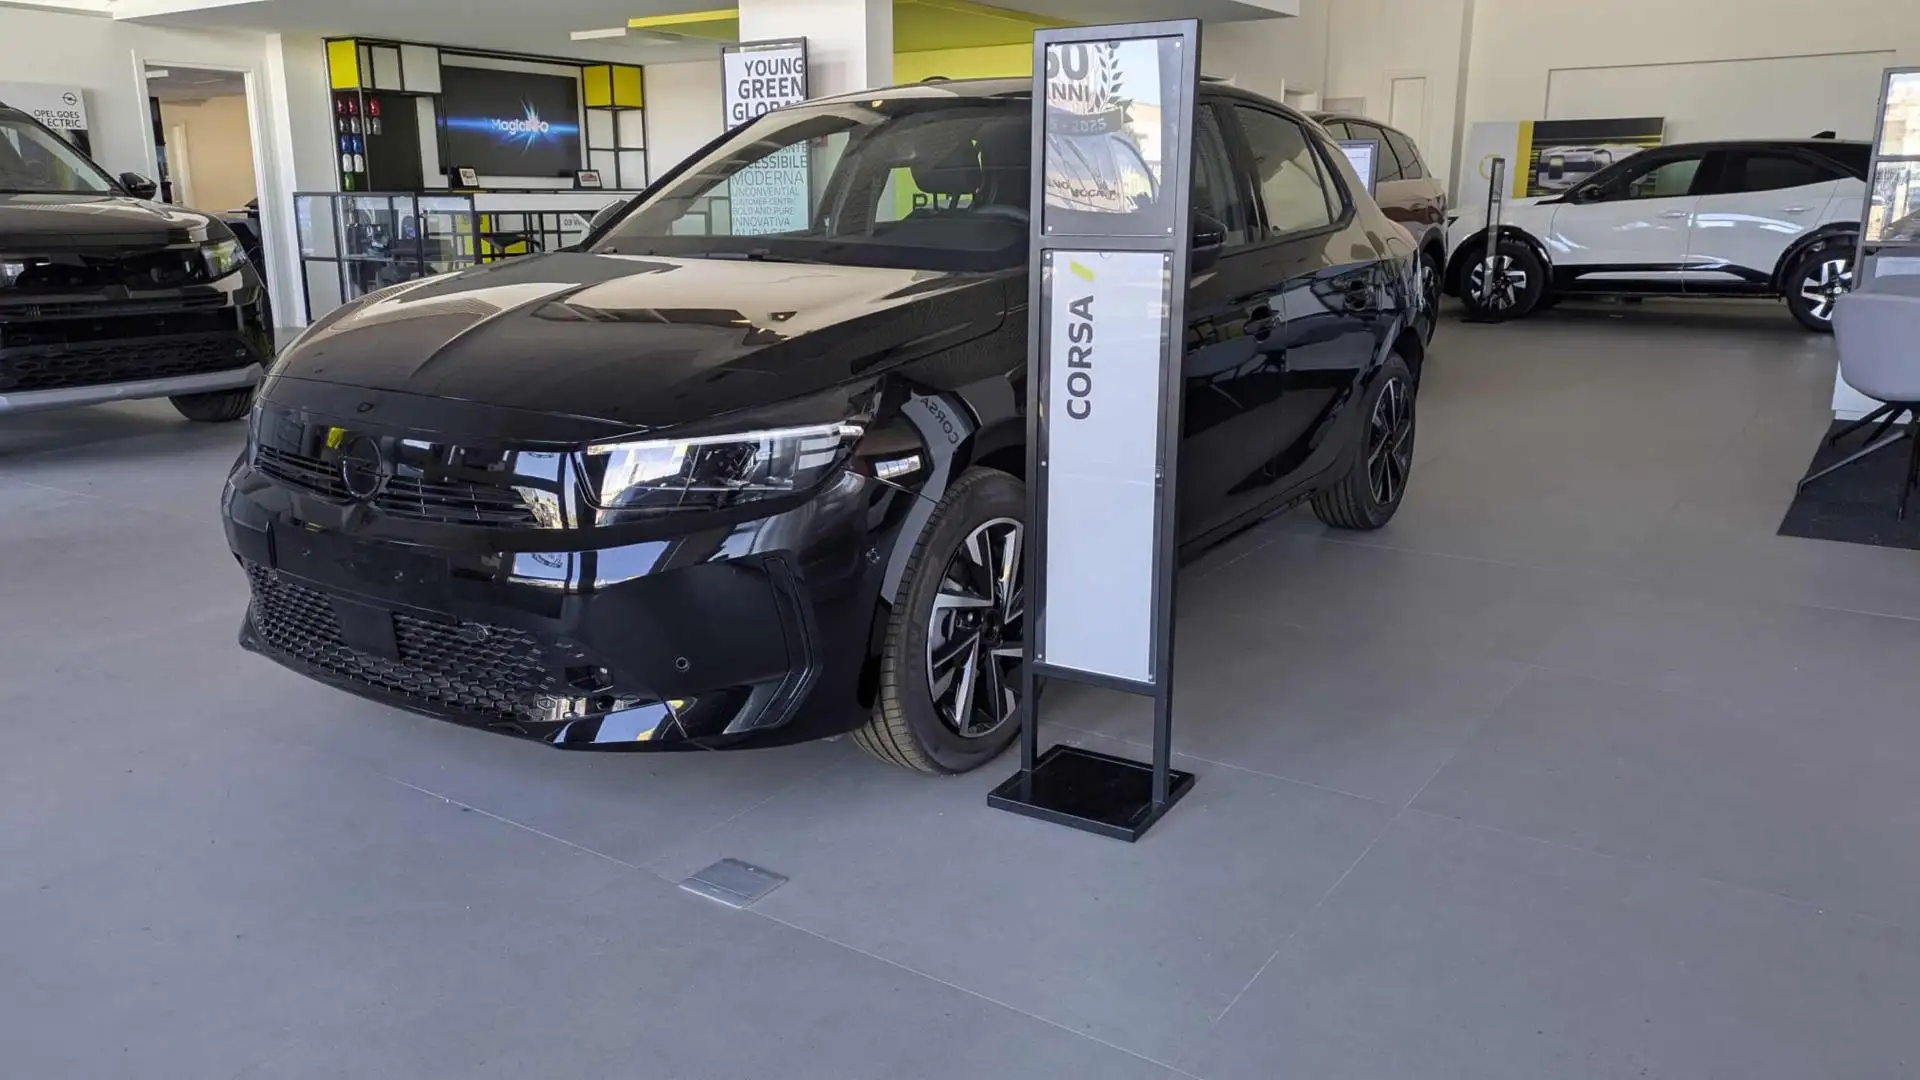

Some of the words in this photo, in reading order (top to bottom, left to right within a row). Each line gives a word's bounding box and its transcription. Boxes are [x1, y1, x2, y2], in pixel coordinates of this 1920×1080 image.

[745, 57, 803, 76] YOUNG
[738, 76, 804, 99] GREEN
[34, 109, 56, 117] OPEL
[56, 110, 80, 119] GOES
[733, 100, 801, 121] GLO
[37, 117, 82, 128] ECTRIC
[731, 170, 804, 186] MODERNA
[732, 216, 790, 226] INNOVATIVA
[1066, 295, 1094, 420] CORSA
